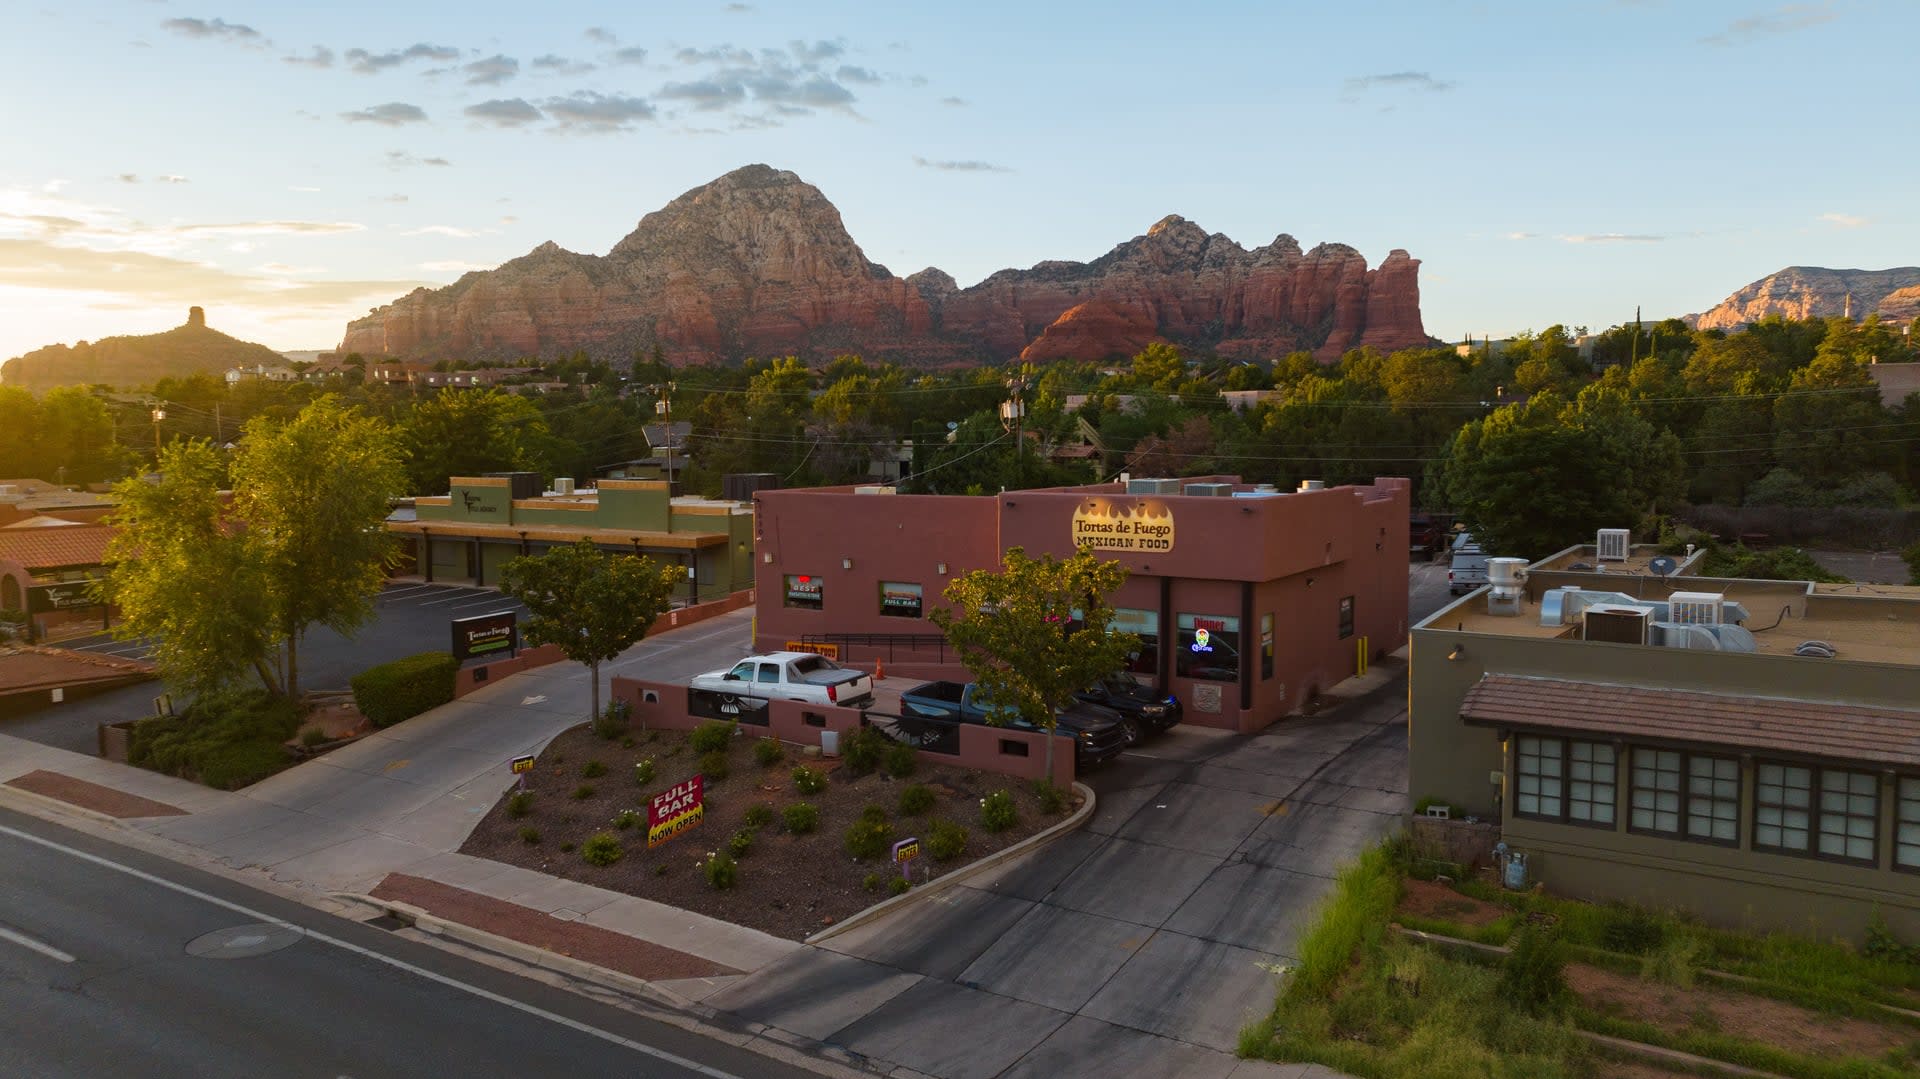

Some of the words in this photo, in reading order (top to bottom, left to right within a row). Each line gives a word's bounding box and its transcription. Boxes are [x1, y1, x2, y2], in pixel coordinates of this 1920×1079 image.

[1075, 520, 1113, 533] Tortas
[1116, 521, 1131, 533] de
[1133, 522, 1171, 538] Fuego
[1076, 536, 1134, 548] MEXICAN
[1139, 539, 1169, 549] FOOD
[654, 780, 698, 808] FULL
[658, 793, 694, 819] BAR
[651, 825, 674, 842] NOW
[676, 811, 701, 832] OPEN
